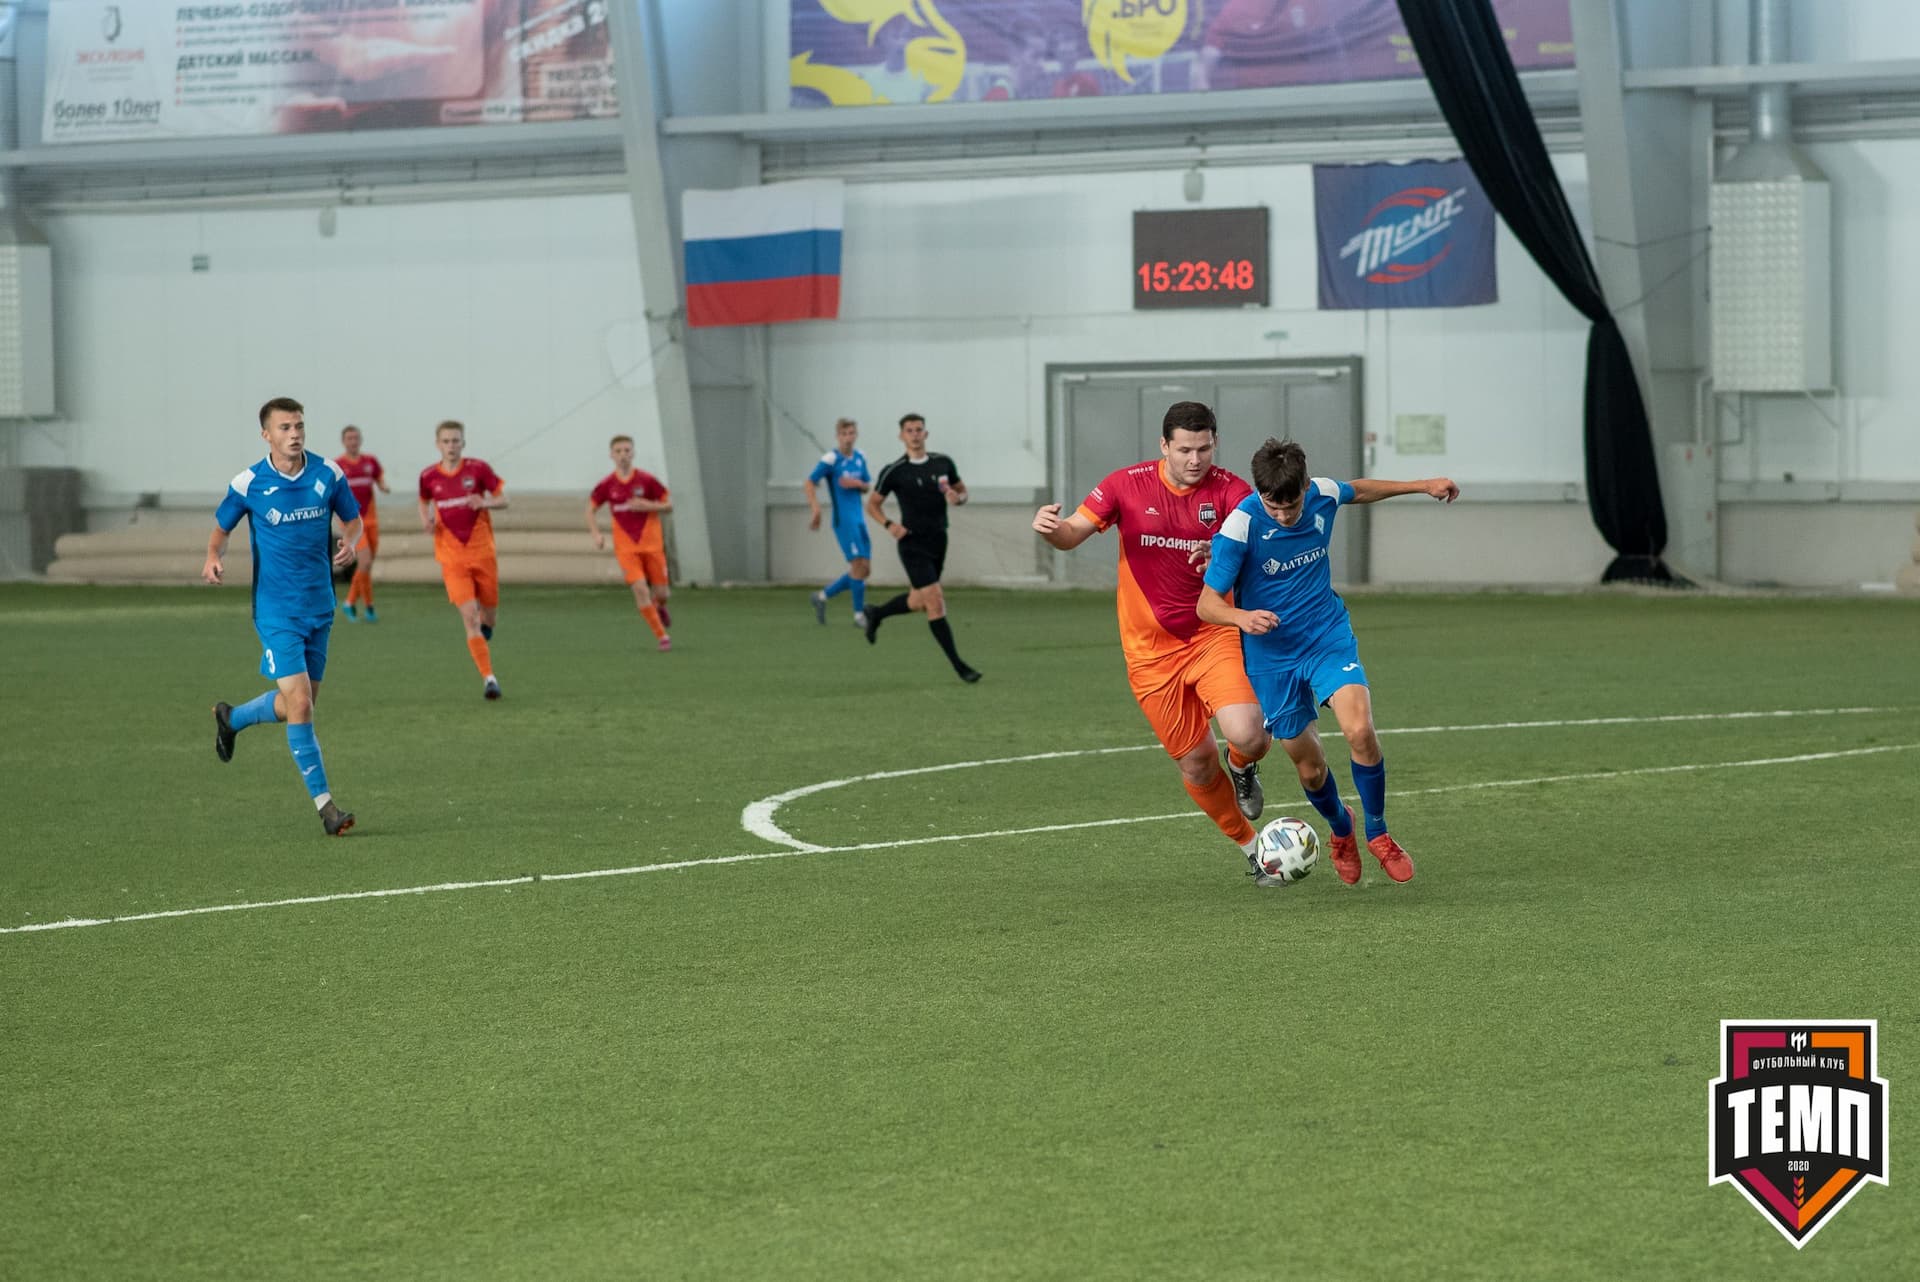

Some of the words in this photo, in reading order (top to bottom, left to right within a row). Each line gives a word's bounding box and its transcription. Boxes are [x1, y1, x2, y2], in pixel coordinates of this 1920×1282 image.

[176, 49, 244, 70] ДЕТСКИЙ
[53, 100, 107, 119] более
[1138, 260, 1255, 292] 15:23:48
[265, 648, 276, 675] 3
